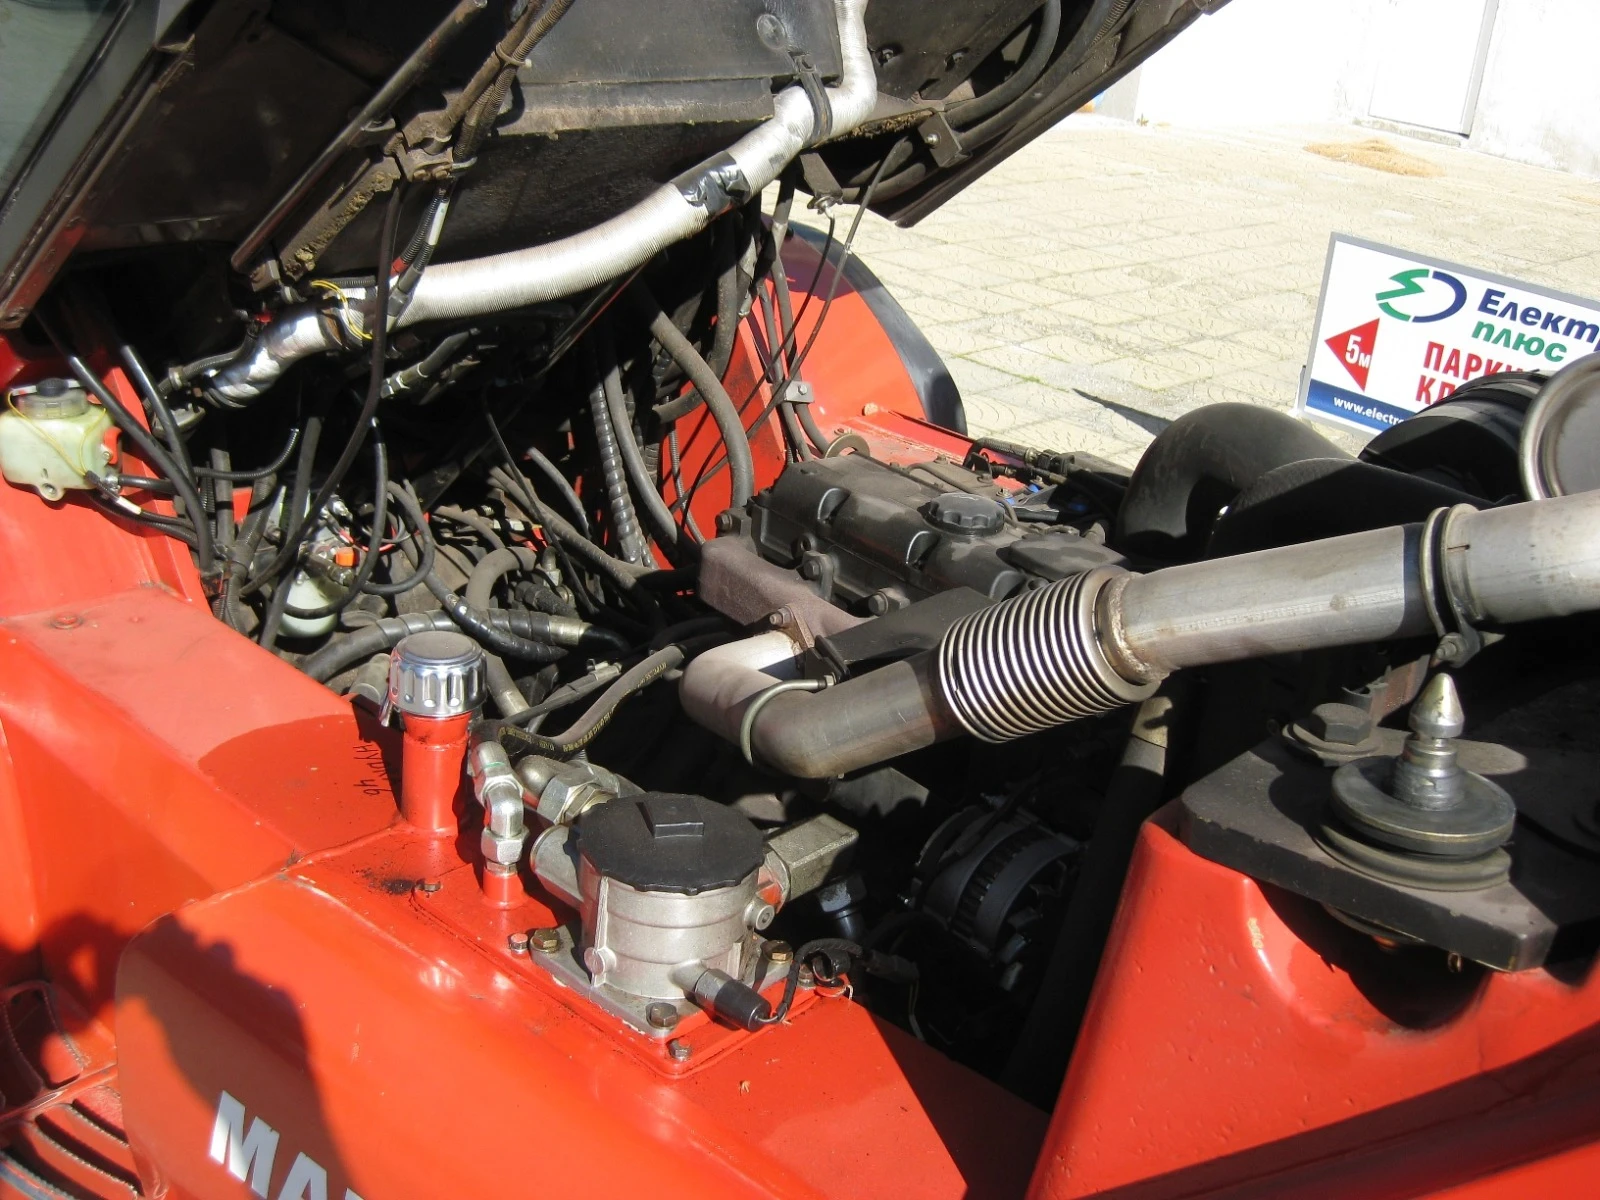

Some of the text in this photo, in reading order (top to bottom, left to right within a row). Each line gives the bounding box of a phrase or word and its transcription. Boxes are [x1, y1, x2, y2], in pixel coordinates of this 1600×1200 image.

[1471, 320, 1567, 363] плюс
[1477, 288, 1600, 352] Елект
[1423, 341, 1524, 381] ПАРК
[209, 1090, 365, 1200] MA
